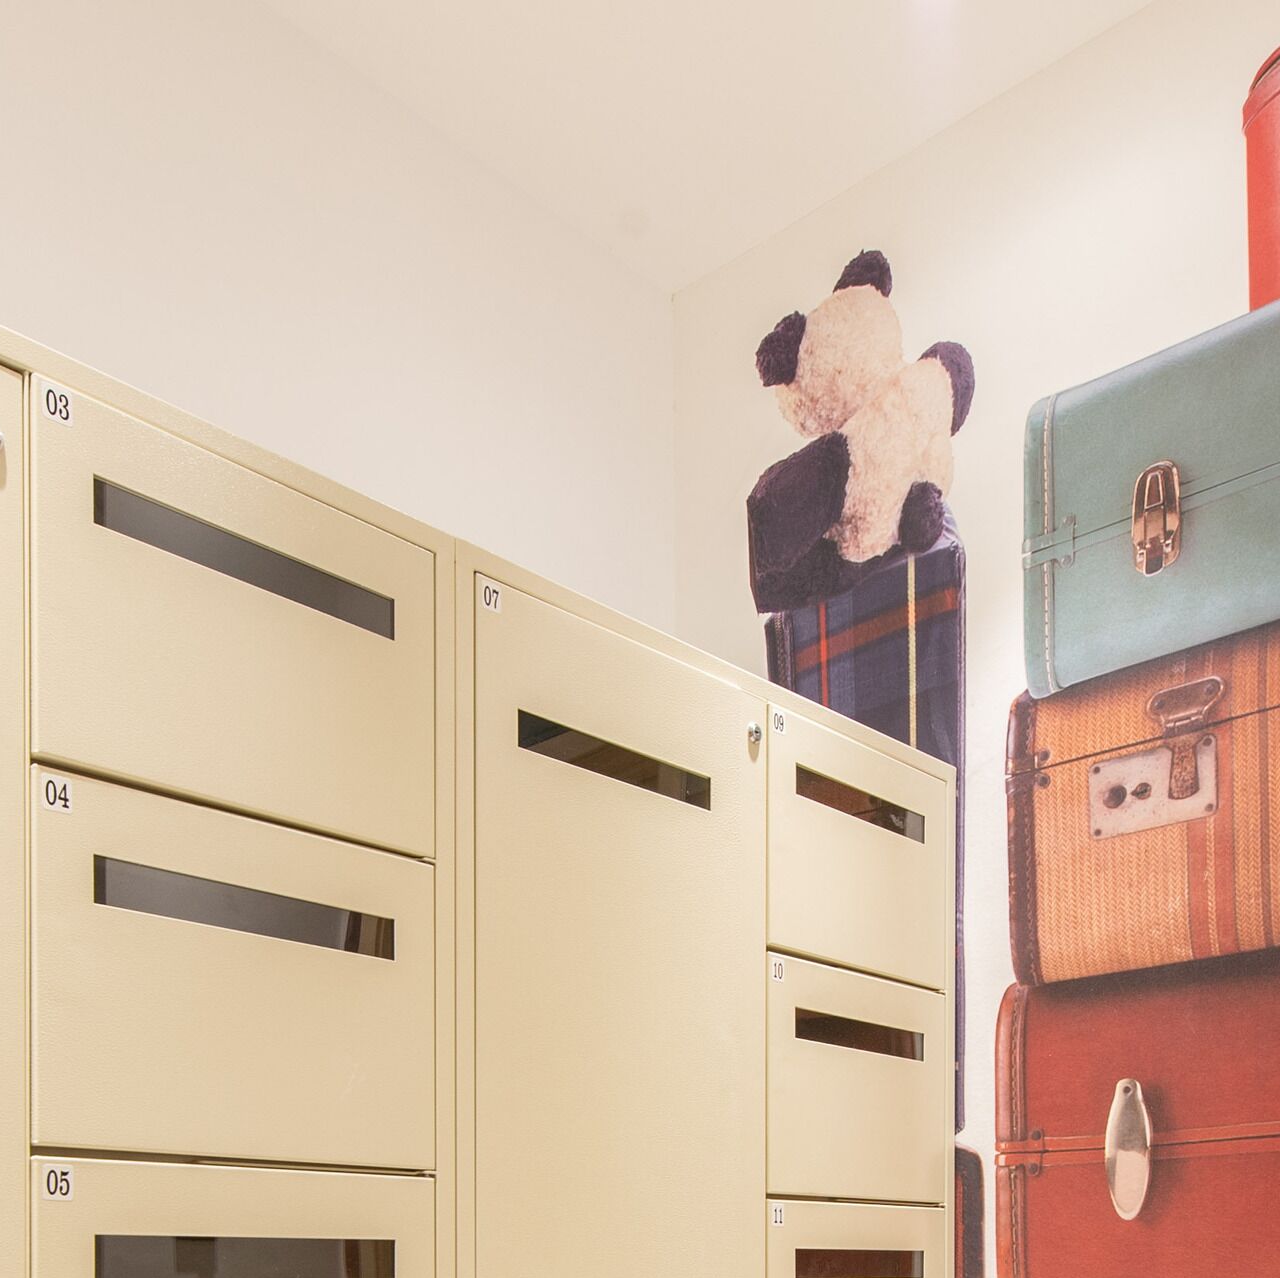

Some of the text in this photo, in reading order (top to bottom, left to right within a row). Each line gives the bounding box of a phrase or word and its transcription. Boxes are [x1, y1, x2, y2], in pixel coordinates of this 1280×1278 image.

[45, 388, 70, 421] 03
[483, 585, 500, 610] 07
[773, 712, 784, 733] 09
[45, 779, 70, 809] 04
[773, 962, 784, 980] 10
[46, 1169, 70, 1196] 05
[774, 1208, 783, 1224] 11
